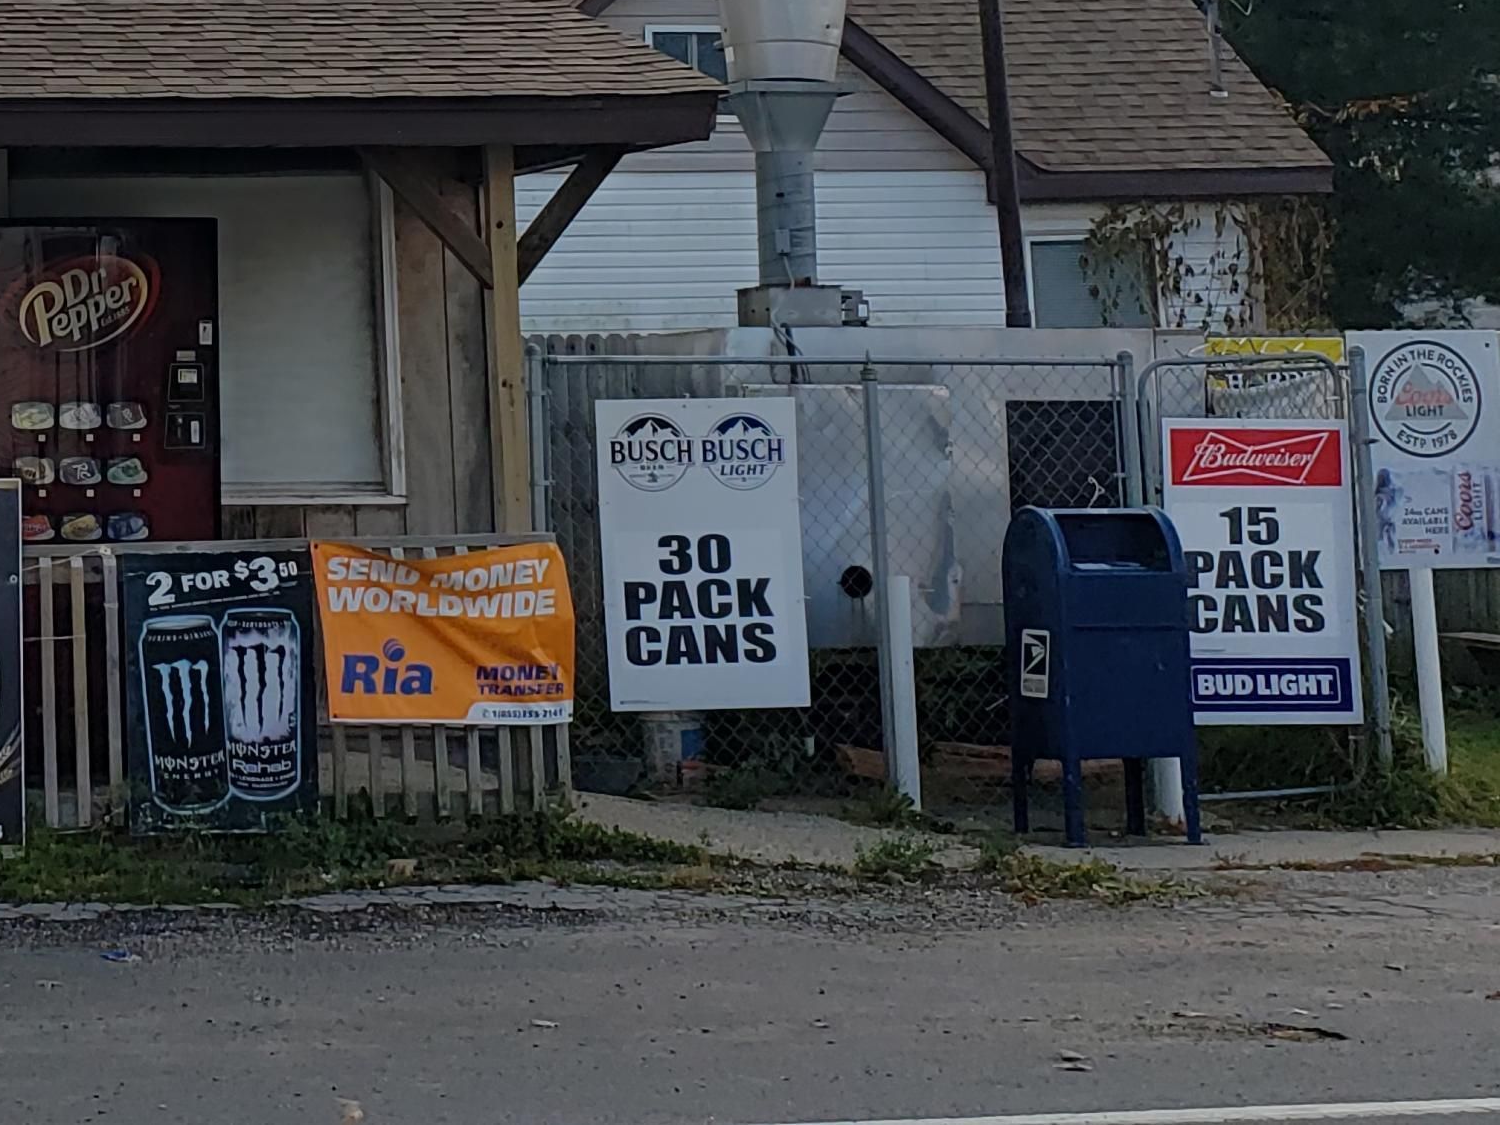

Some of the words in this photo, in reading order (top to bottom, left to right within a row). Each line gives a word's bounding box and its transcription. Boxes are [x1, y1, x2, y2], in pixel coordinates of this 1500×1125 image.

[61, 267, 107, 307] Dr
[20, 276, 137, 347] Pepper
[1377, 366, 1395, 403] BORN
[1393, 354, 1408, 369] IN
[1409, 350, 1435, 361] THE
[1437, 353, 1473, 403] ROCKIES
[1405, 405, 1445, 417] LIGHT
[610, 439, 693, 464] BUSCH
[702, 438, 784, 463] BUSCH
[1194, 443, 1313, 468] Budweiser
[1431, 429, 1458, 448] 1978
[720, 464, 767, 476] LIGHT
[1424, 507, 1449, 515] CANS
[1455, 472, 1474, 531] Coors
[1219, 506, 1279, 545] 15
[1401, 517, 1449, 525] AVAILABLE
[657, 533, 732, 575] 30
[1184, 550, 1323, 589] PACK
[146, 571, 175, 606] 2
[181, 570, 230, 592] FOR
[327, 556, 421, 586] SEND
[430, 558, 550, 592] MONEY
[327, 585, 556, 619] WORLDWIDE
[623, 577, 774, 621] PACK
[1187, 594, 1325, 634] CANS
[625, 622, 777, 666] CANS
[340, 638, 433, 696] Ria
[476, 663, 559, 681] MONEY
[1197, 674, 1254, 695] BUD
[1256, 673, 1333, 695] LIGHT
[477, 683, 565, 696] TRANSFER
[154, 749, 225, 772] MONSTER
[227, 740, 297, 759] MONSTER
